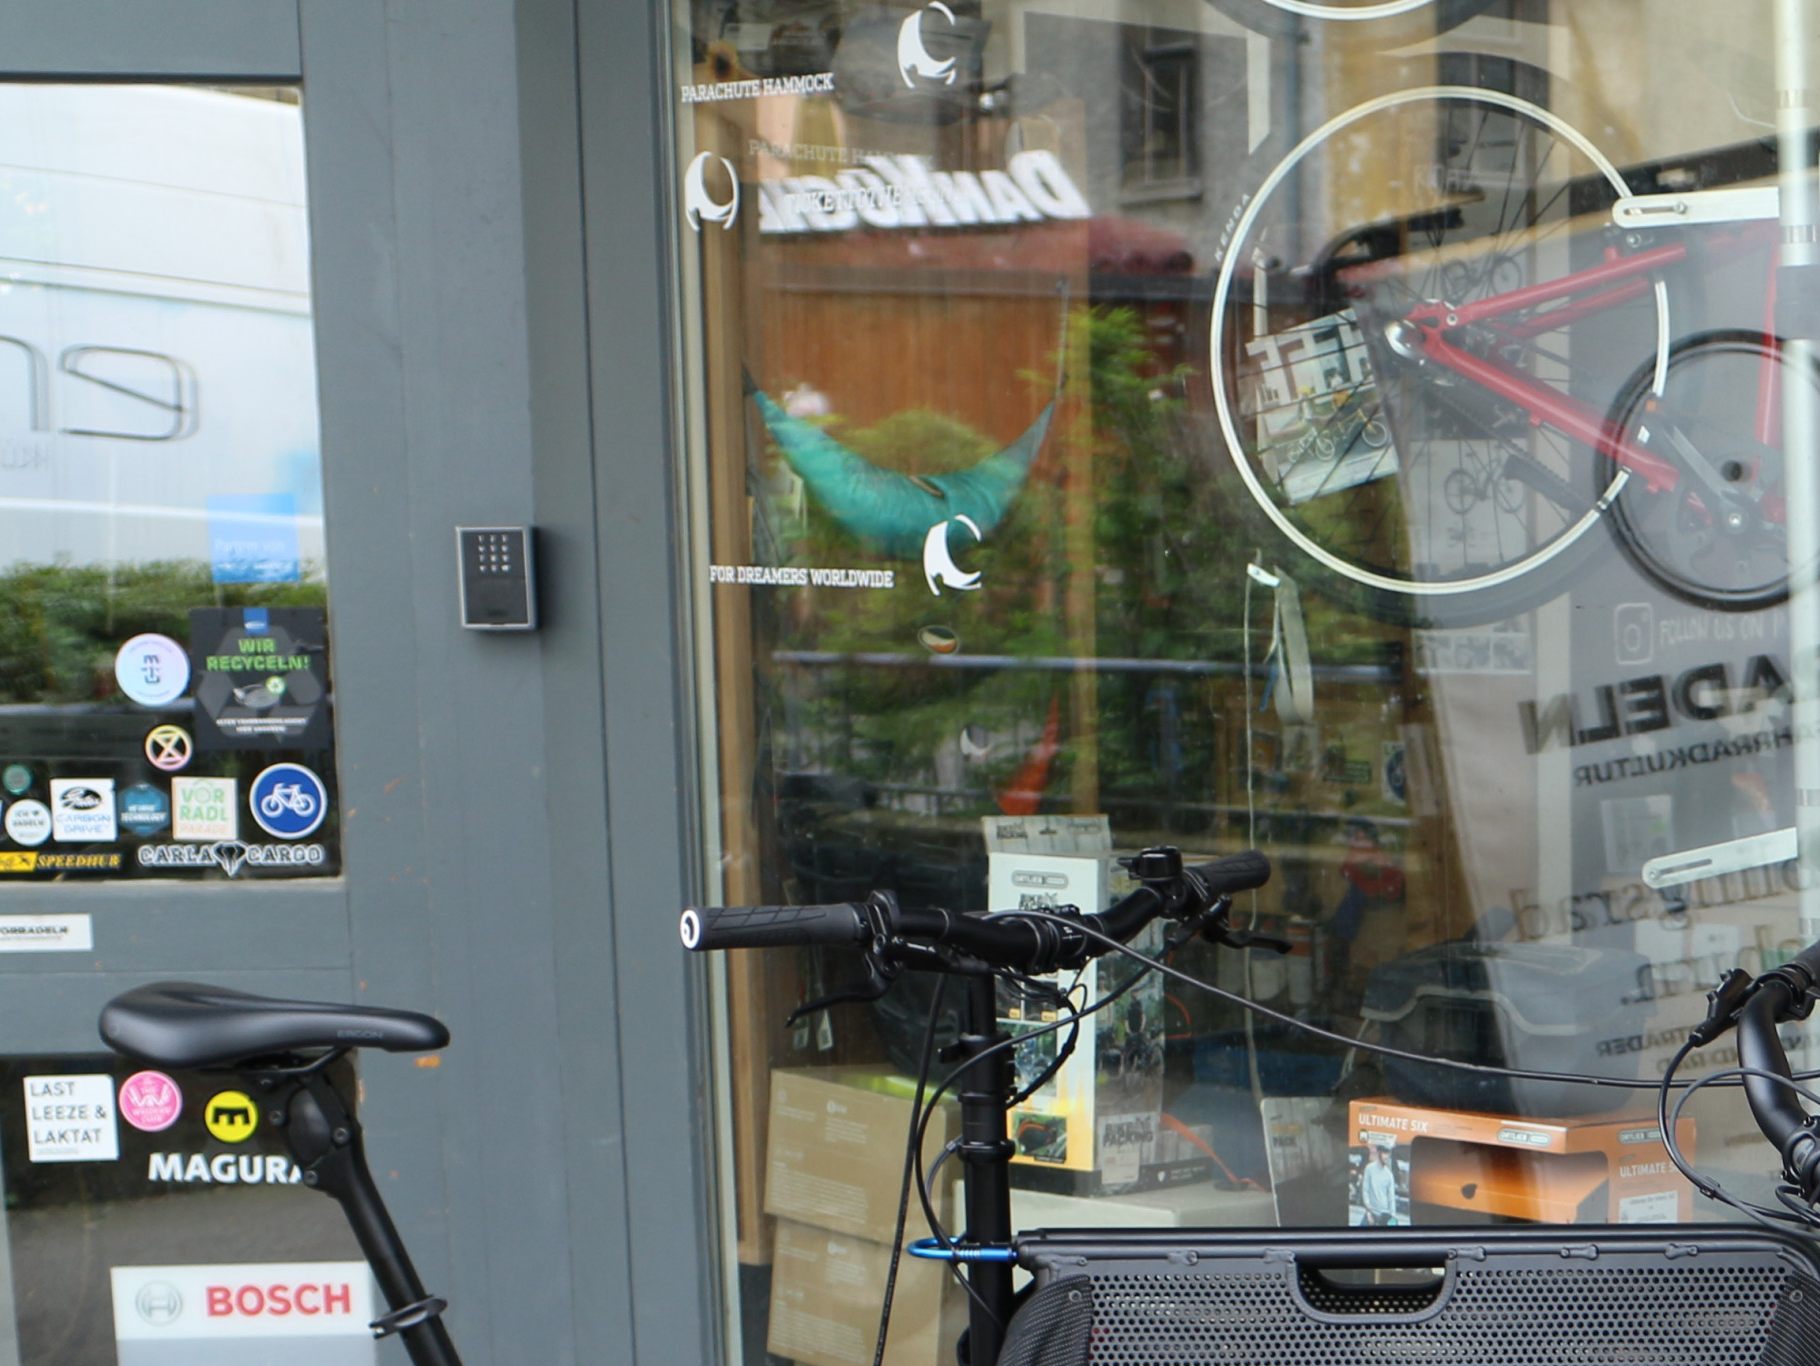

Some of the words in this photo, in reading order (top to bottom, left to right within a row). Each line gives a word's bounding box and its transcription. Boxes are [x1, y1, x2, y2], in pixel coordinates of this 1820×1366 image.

[681, 85, 761, 103] PARACHUTE
[763, 73, 835, 96] HAMMOCK
[1213, 193, 1250, 261] KENDA
[710, 565, 734, 583] FOR
[737, 566, 808, 586] DREAMERS
[811, 569, 894, 588] WORLDWIDE
[238, 638, 276, 653] WIR
[205, 656, 311, 672] RECYCELN!
[181, 788, 224, 801] VOR
[56, 814, 110, 822] CARBON
[180, 806, 228, 821] RADL
[64, 824, 101, 833] DRIVE
[37, 854, 121, 868] SPEEDHUB
[138, 845, 216, 865] CARLA
[246, 845, 324, 864] CARGO
[30, 1082, 75, 1097] LAST
[32, 1105, 86, 1120] LEEZE
[96, 1106, 107, 1119] &
[1358, 1113, 1408, 1129] ULTIMATE
[1410, 1120, 1429, 1132] SIX
[34, 1128, 101, 1144] LAKTAT
[1619, 1163, 1668, 1177] ULTIMATE
[206, 1283, 351, 1317] BOSCH
